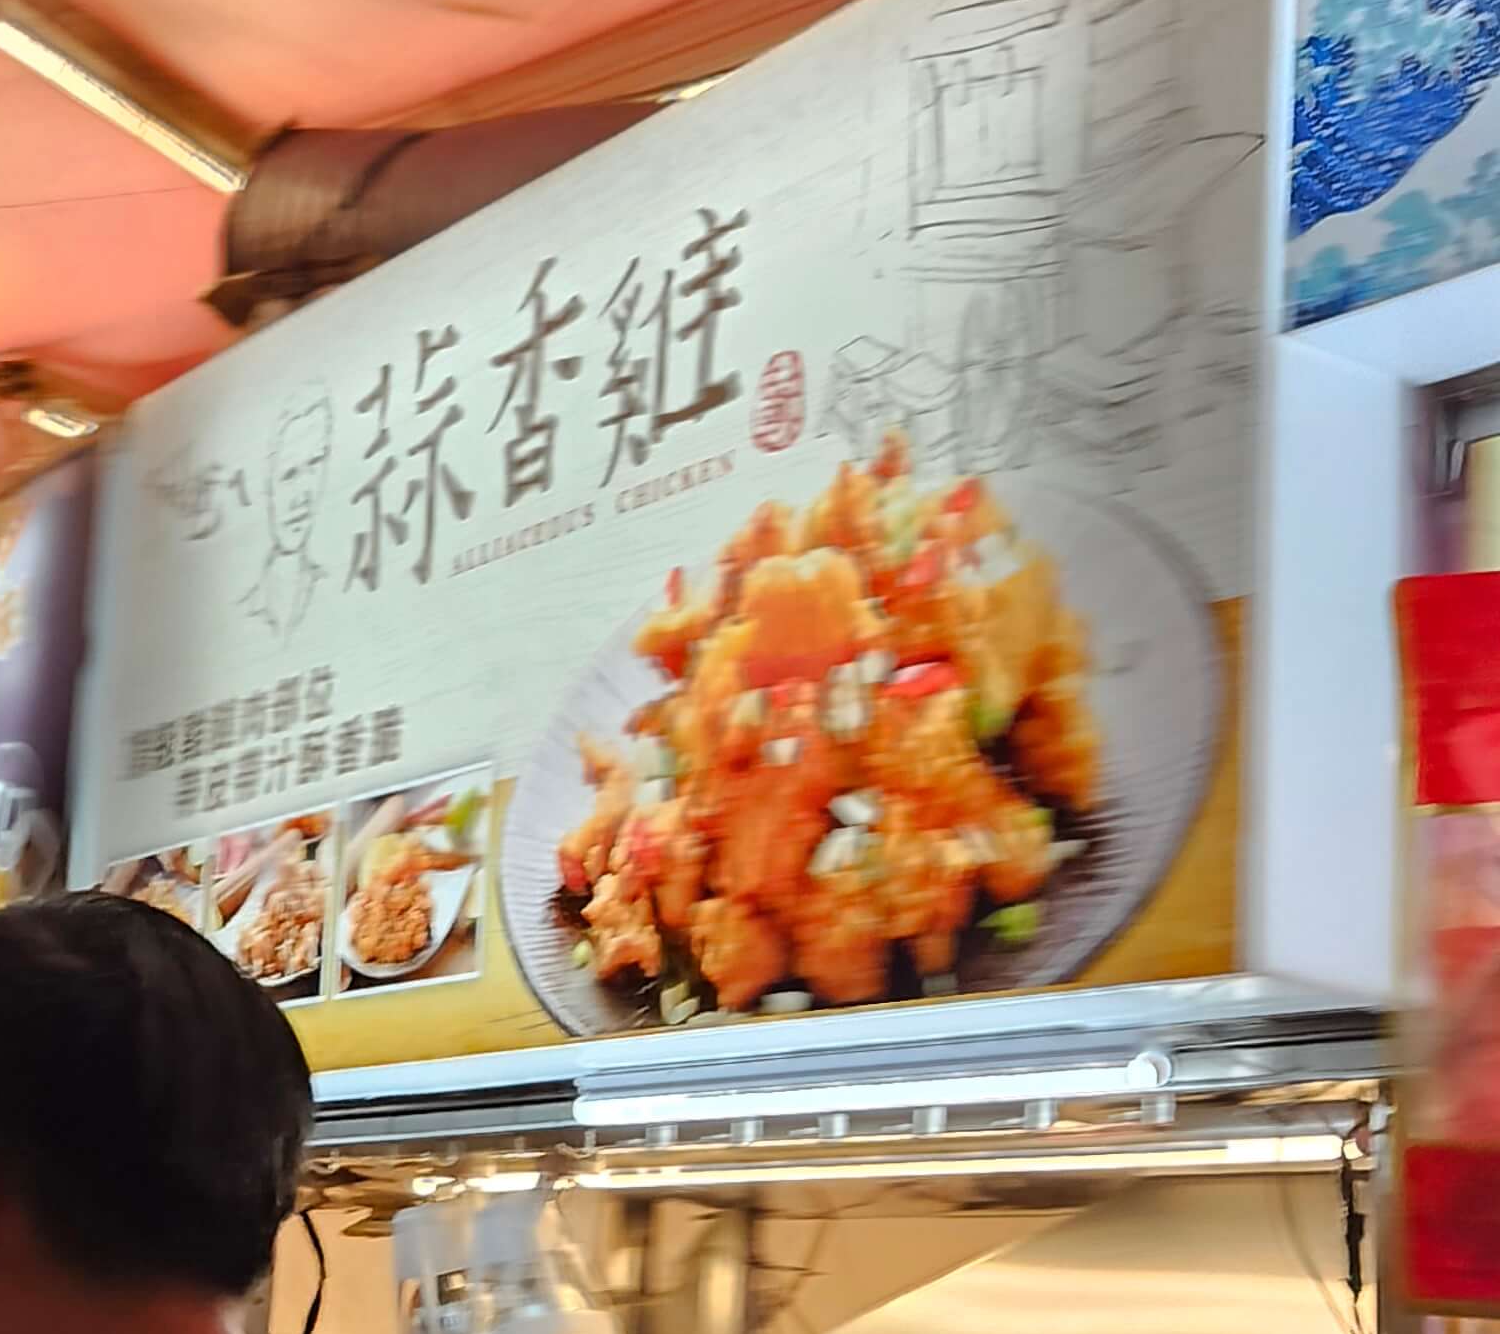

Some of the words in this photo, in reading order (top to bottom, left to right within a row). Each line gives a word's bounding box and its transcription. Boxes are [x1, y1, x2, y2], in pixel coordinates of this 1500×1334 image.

[343, 208, 750, 593] 蒜香雞
[615, 450, 736, 514] CHICKEN
